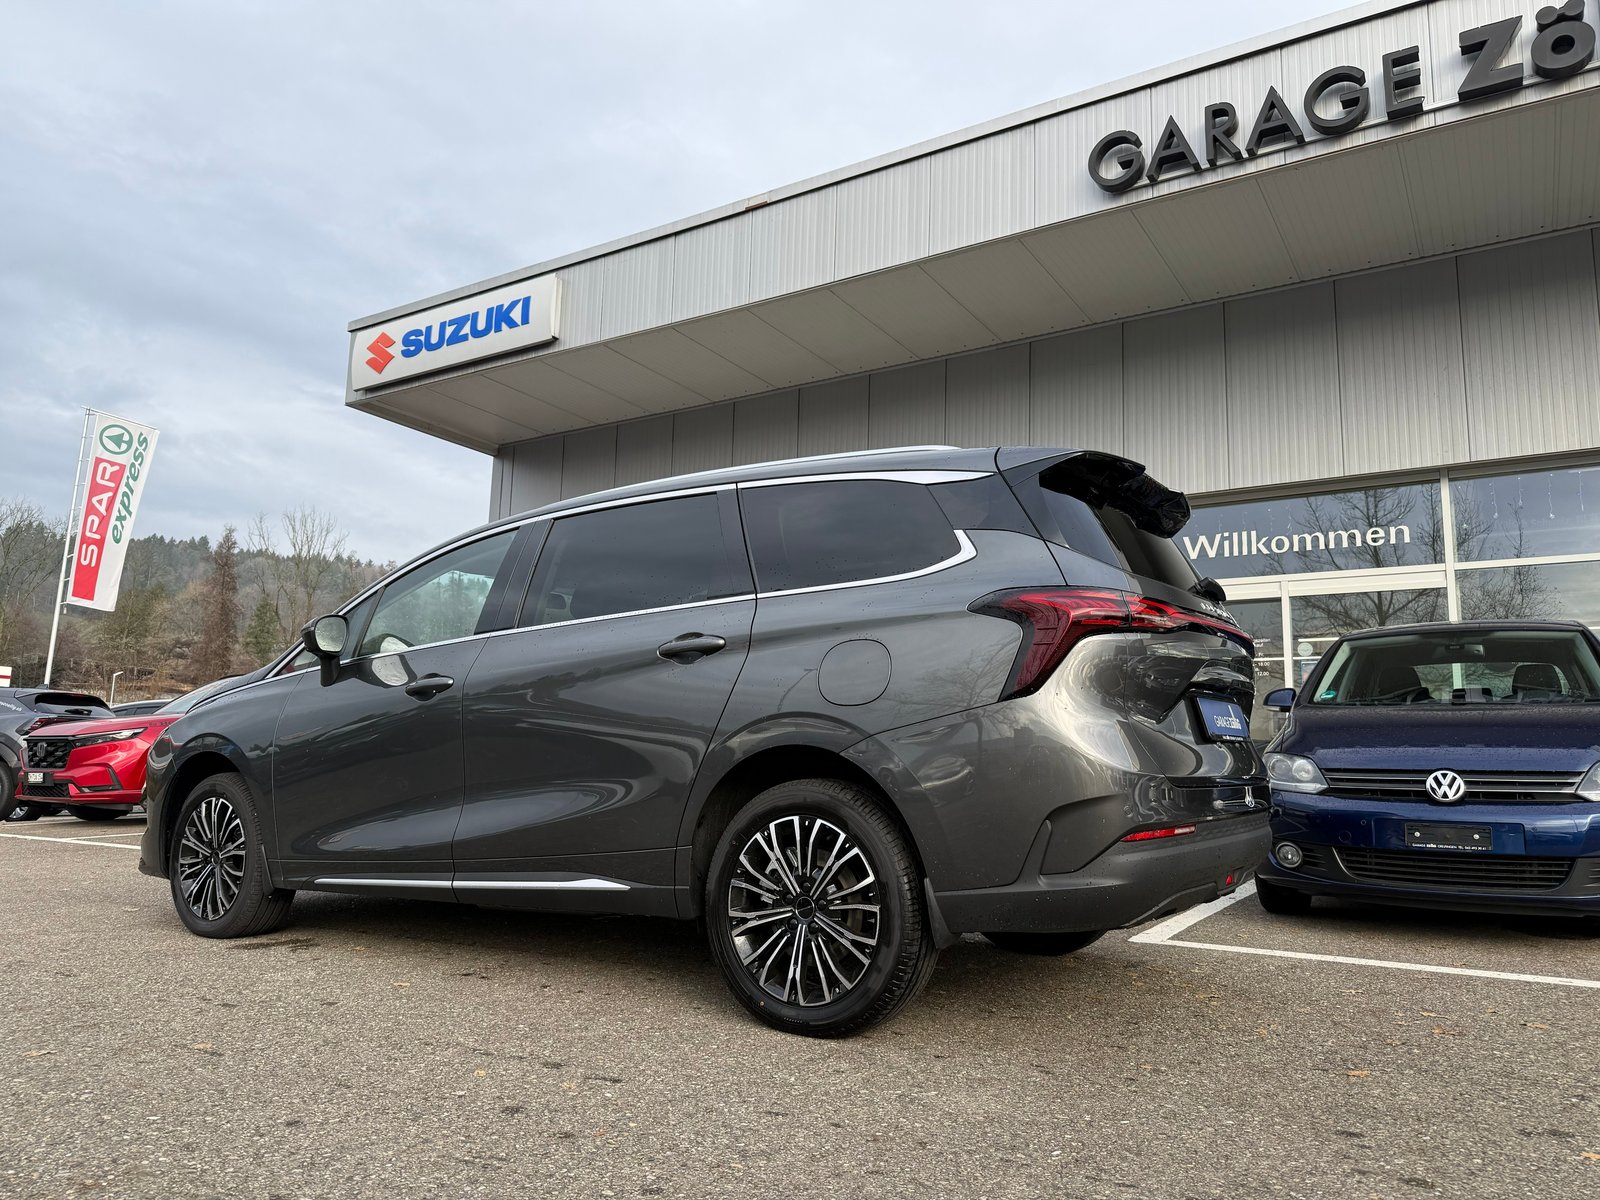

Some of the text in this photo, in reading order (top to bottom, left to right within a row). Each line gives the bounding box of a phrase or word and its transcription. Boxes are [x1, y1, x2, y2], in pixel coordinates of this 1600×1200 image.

[1088, 45, 1424, 193] GARAGE
[401, 295, 532, 358] SUZUKI
[80, 462, 120, 568] SPAR
[112, 432, 149, 544] express
[1183, 525, 1411, 560] Willkommen
